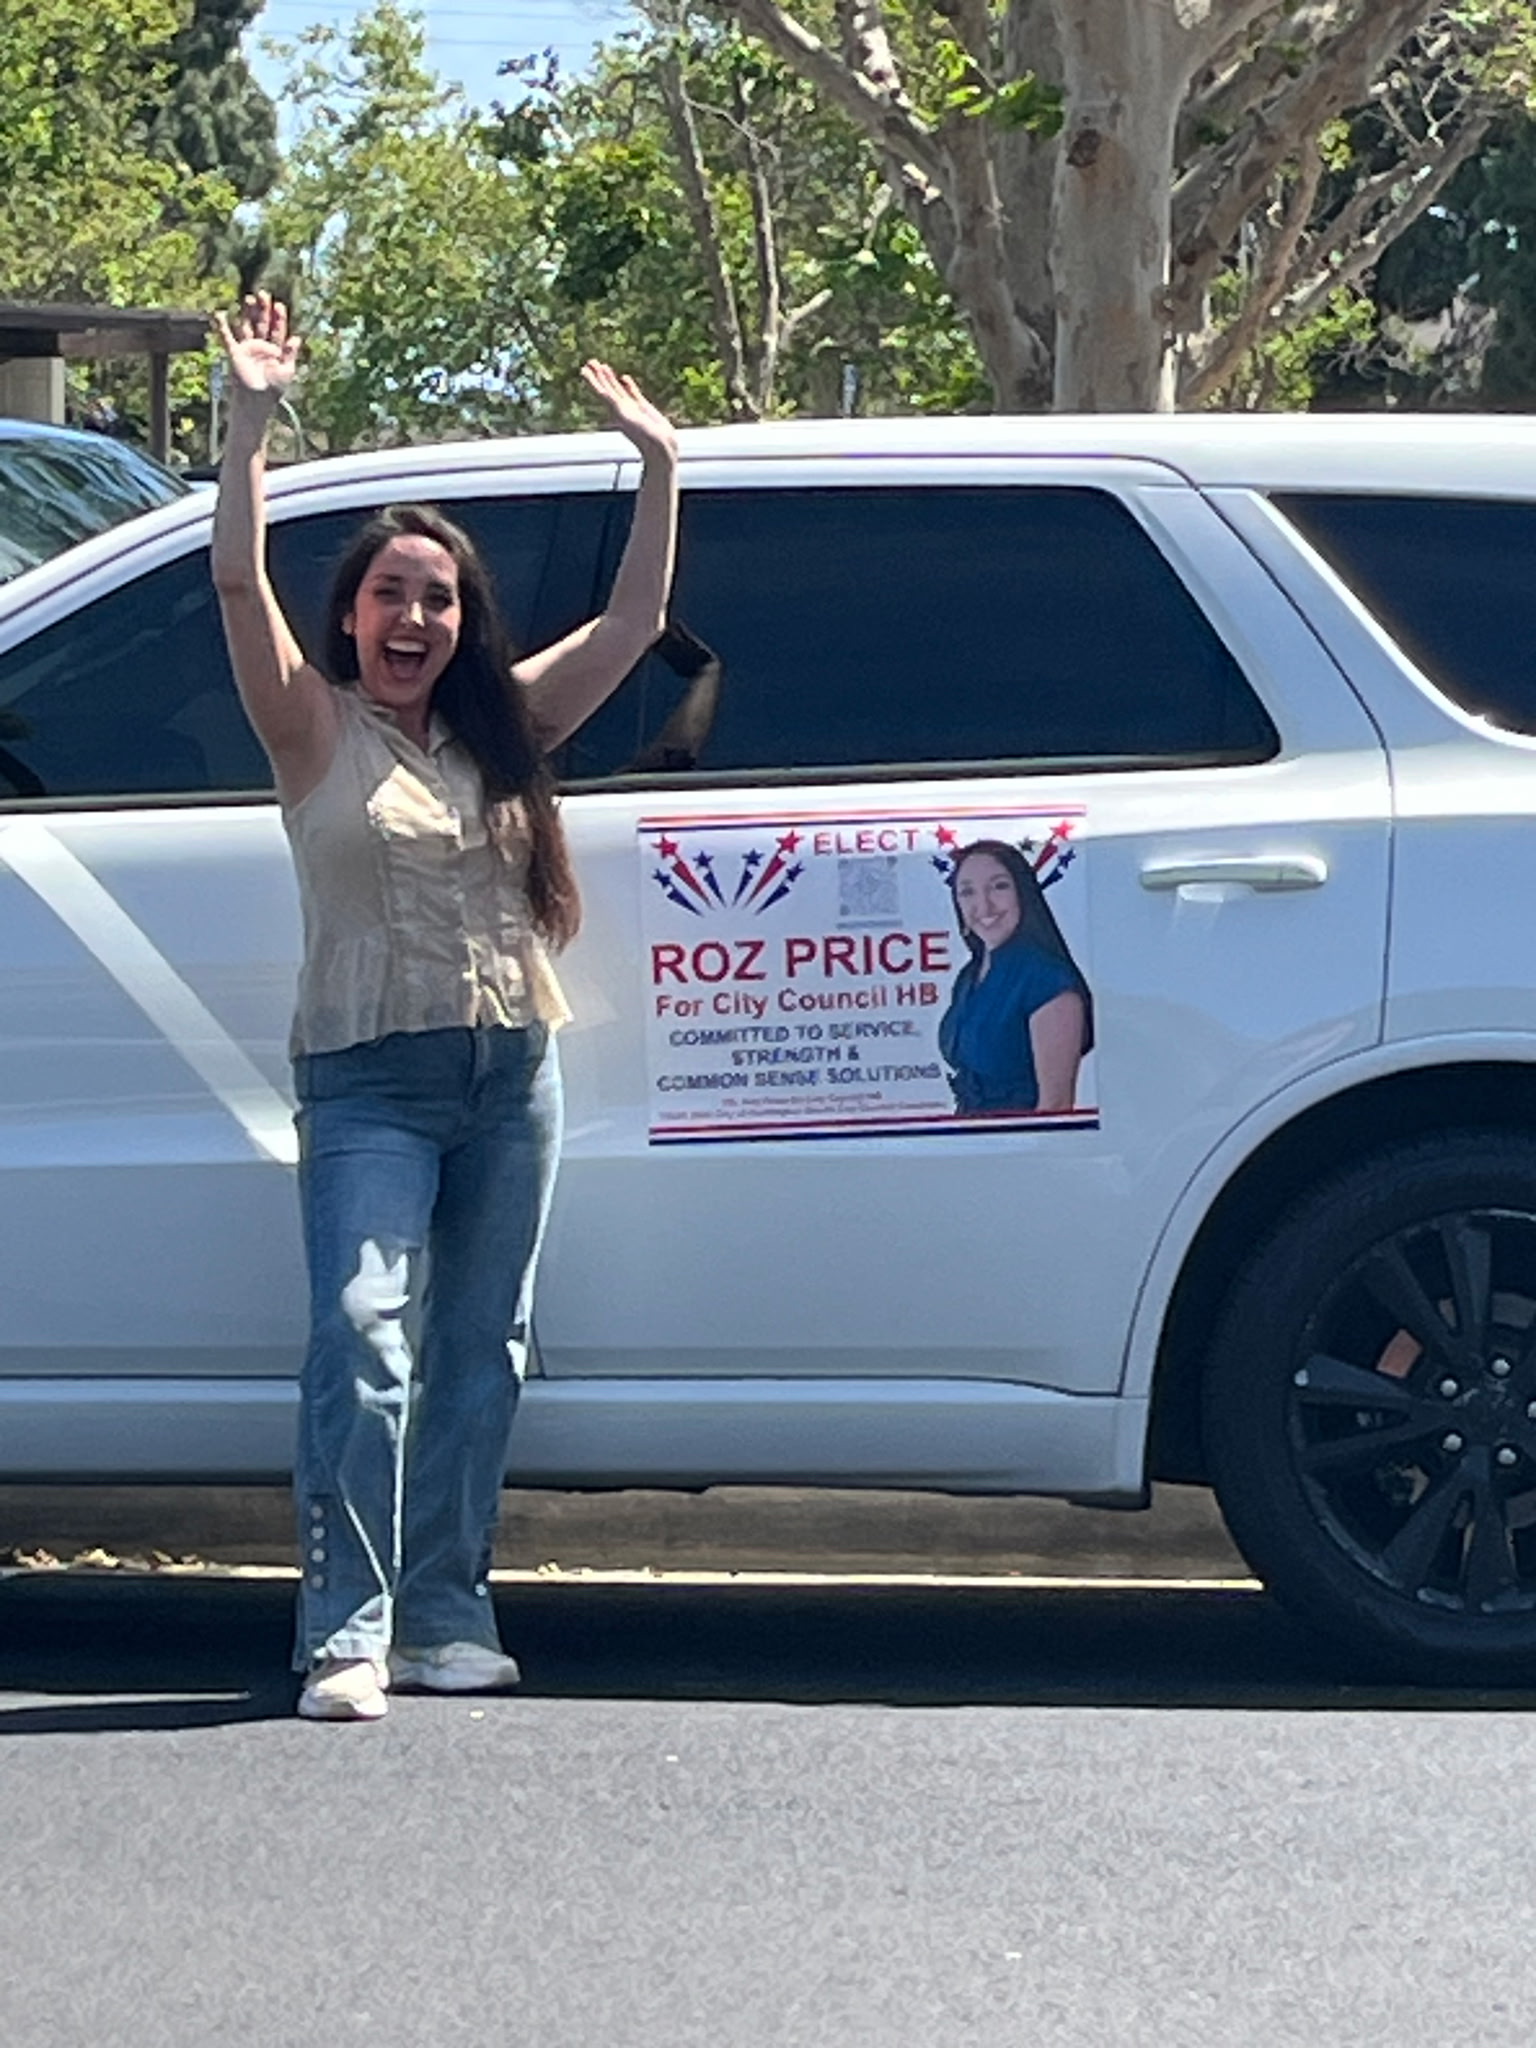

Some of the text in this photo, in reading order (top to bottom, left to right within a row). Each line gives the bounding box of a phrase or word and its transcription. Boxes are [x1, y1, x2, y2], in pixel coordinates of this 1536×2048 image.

[813, 829, 920, 856] ELECT
[651, 931, 951, 984] ROZ PRICE
[656, 982, 939, 1019] For City Council HB
[669, 1026, 789, 1047] COMMITTED
[794, 1024, 824, 1040] TO
[731, 1045, 860, 1066] STRENGTH &
[656, 1063, 942, 1092] COMMON SENSE SOLUTIONS
